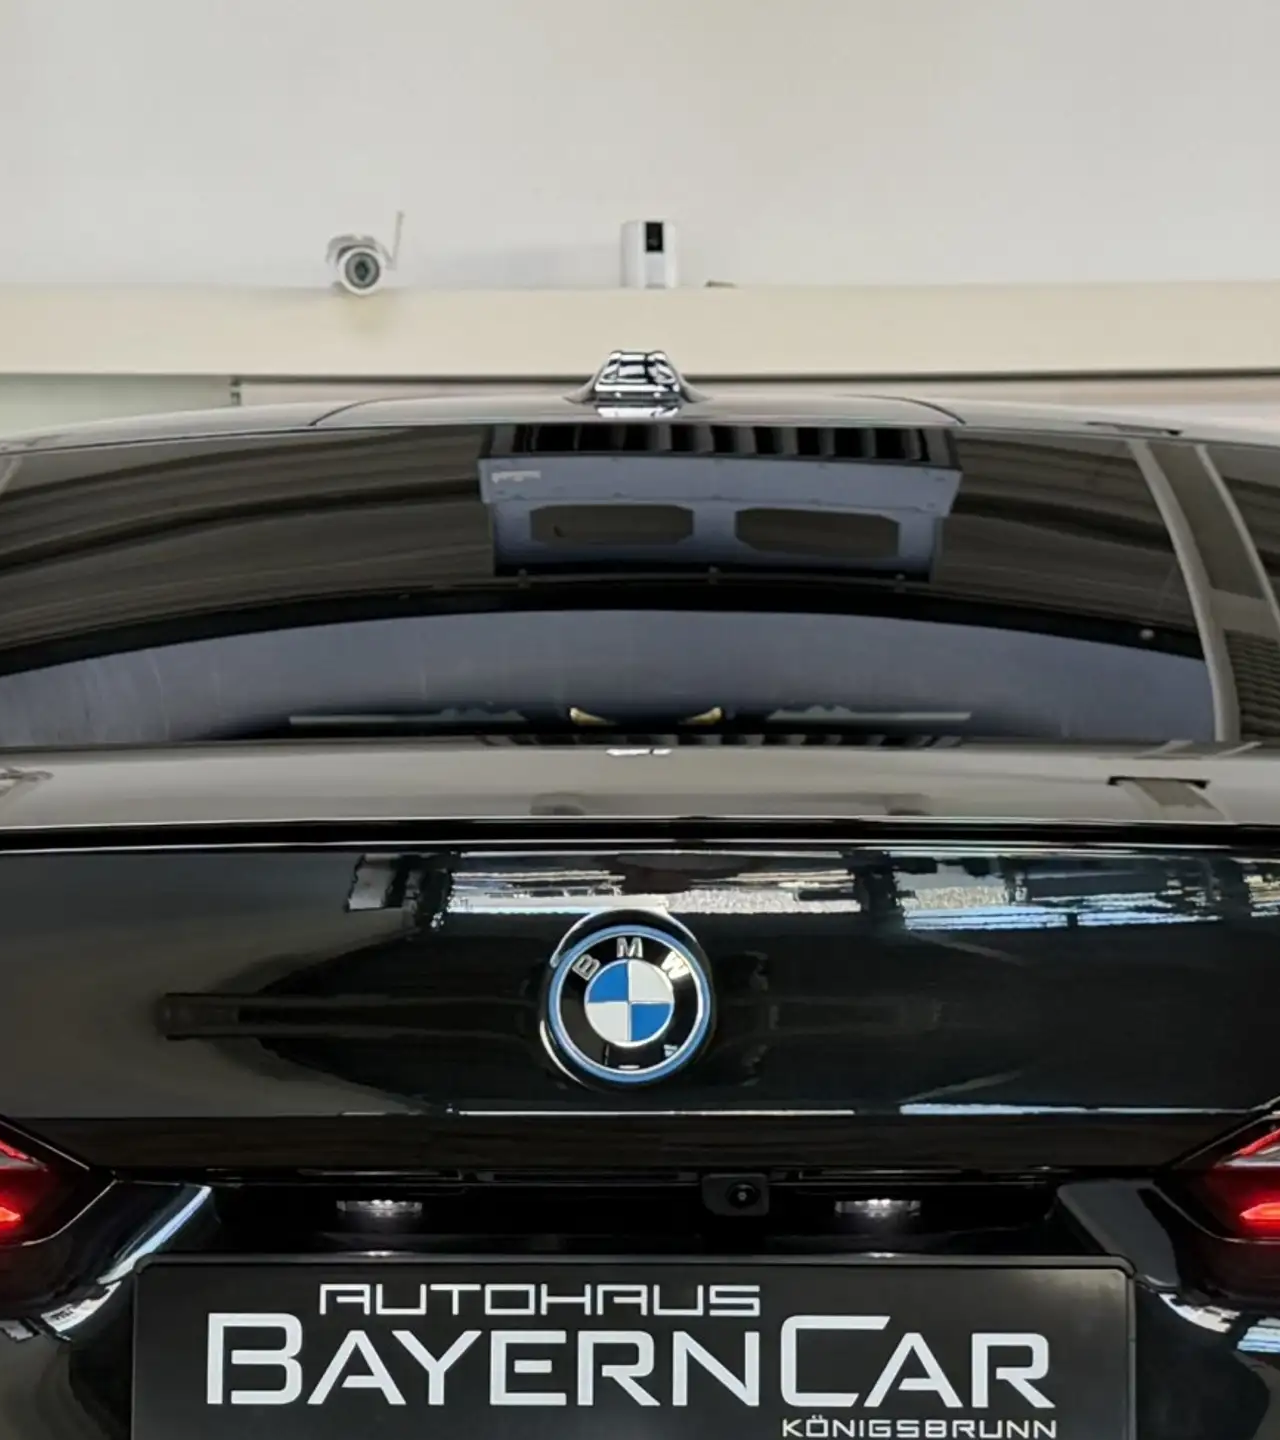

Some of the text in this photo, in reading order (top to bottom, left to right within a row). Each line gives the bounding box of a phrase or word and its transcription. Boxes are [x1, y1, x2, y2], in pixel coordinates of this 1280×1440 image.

[571, 937, 690, 982] BMW
[319, 1283, 762, 1317] AUTOHAUS
[206, 1311, 1056, 1409] BAYERNCAR
[782, 1414, 1058, 1440] KÖNIGSBRUNN
